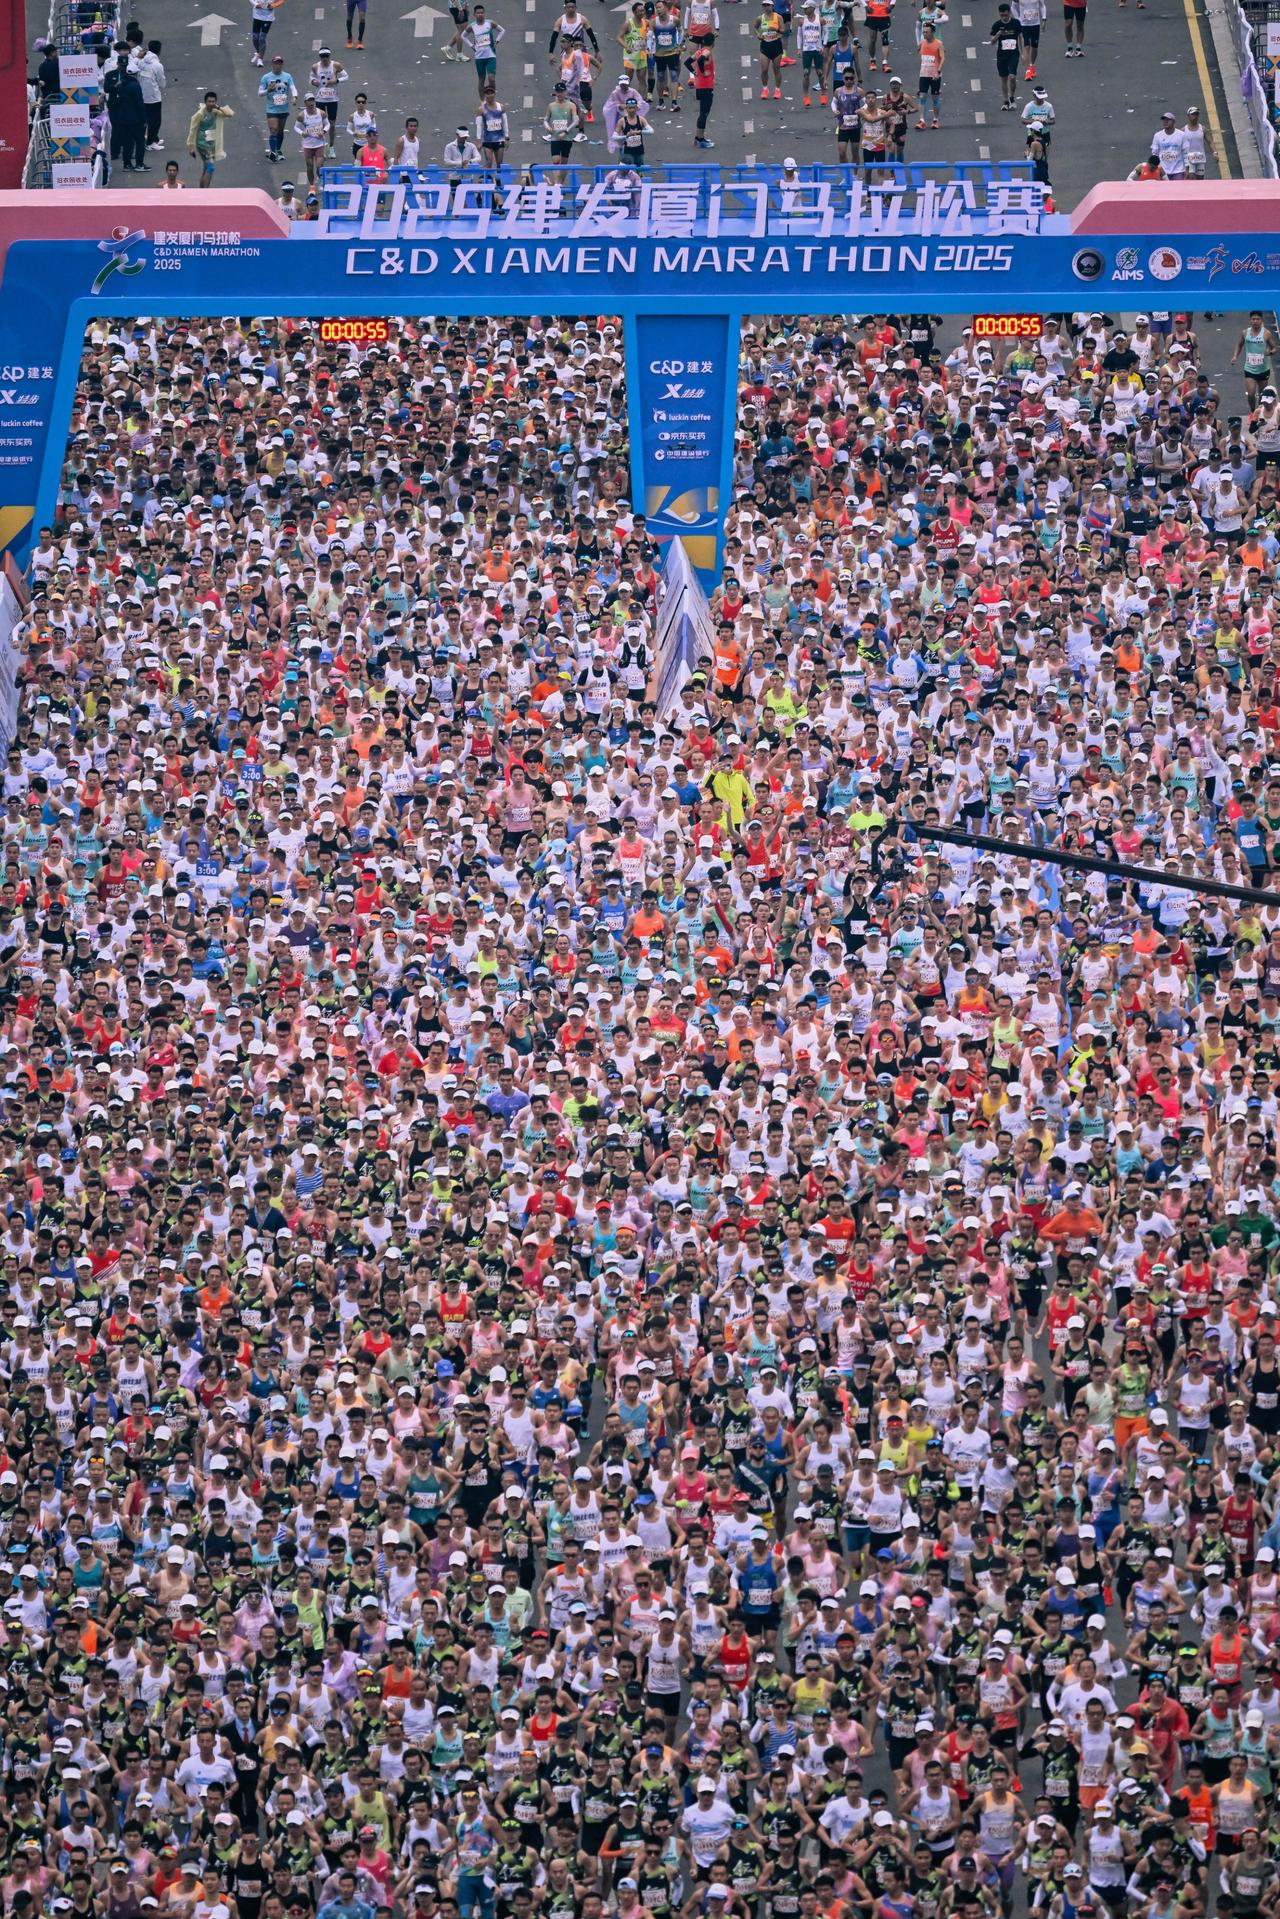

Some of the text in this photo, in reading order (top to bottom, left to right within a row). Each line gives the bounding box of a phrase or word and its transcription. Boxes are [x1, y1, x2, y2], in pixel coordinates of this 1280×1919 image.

[316, 178, 1046, 240] 2025建发厦门马拉松赛
[153, 231, 241, 245] 建发厦门马拉松
[153, 247, 260, 257] C&D XIAMEN MARATHON
[154, 258, 182, 270] 2025
[345, 246, 439, 276] C&D
[451, 245, 637, 275] XIAMEN
[1111, 269, 1144, 281] AIMS
[321, 321, 388, 340] 00:00:55
[975, 317, 1042, 335] 00:00:55
[0, 366, 54, 382] &D 建发
[650, 360, 713, 376] C&D 建发
[1, 419, 44, 427] luckin coffee
[668, 413, 711, 421] luckin coffee
[670, 432, 706, 440] 京东买药
[242, 770, 261, 780] 3:00
[197, 866, 217, 875] 3:00
